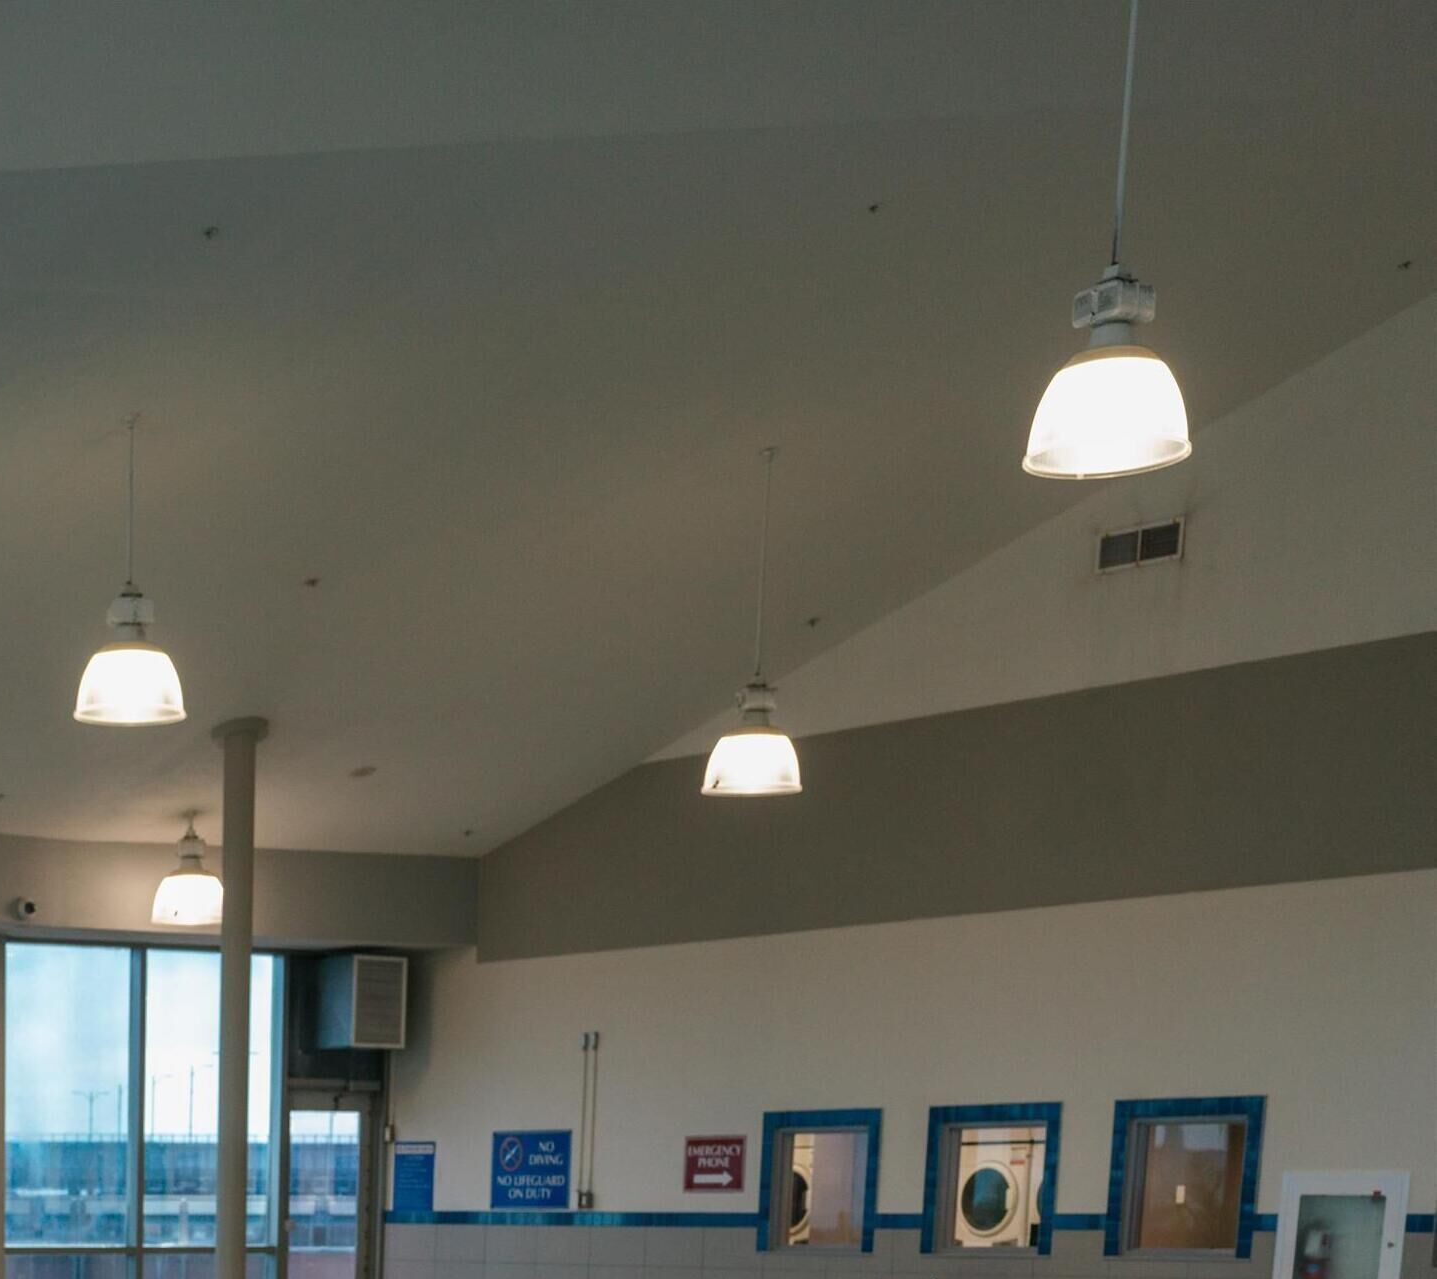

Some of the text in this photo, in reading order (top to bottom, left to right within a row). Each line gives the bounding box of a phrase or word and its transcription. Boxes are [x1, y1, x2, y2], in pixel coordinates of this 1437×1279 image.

[538, 1141, 555, 1152] NO
[688, 1144, 741, 1157] EMERGENCY
[528, 1154, 564, 1165] DIVING
[698, 1157, 730, 1168] PHONE
[497, 1175, 566, 1186] NO LIFEGUARD
[508, 1187, 552, 1199] ON DUTY
